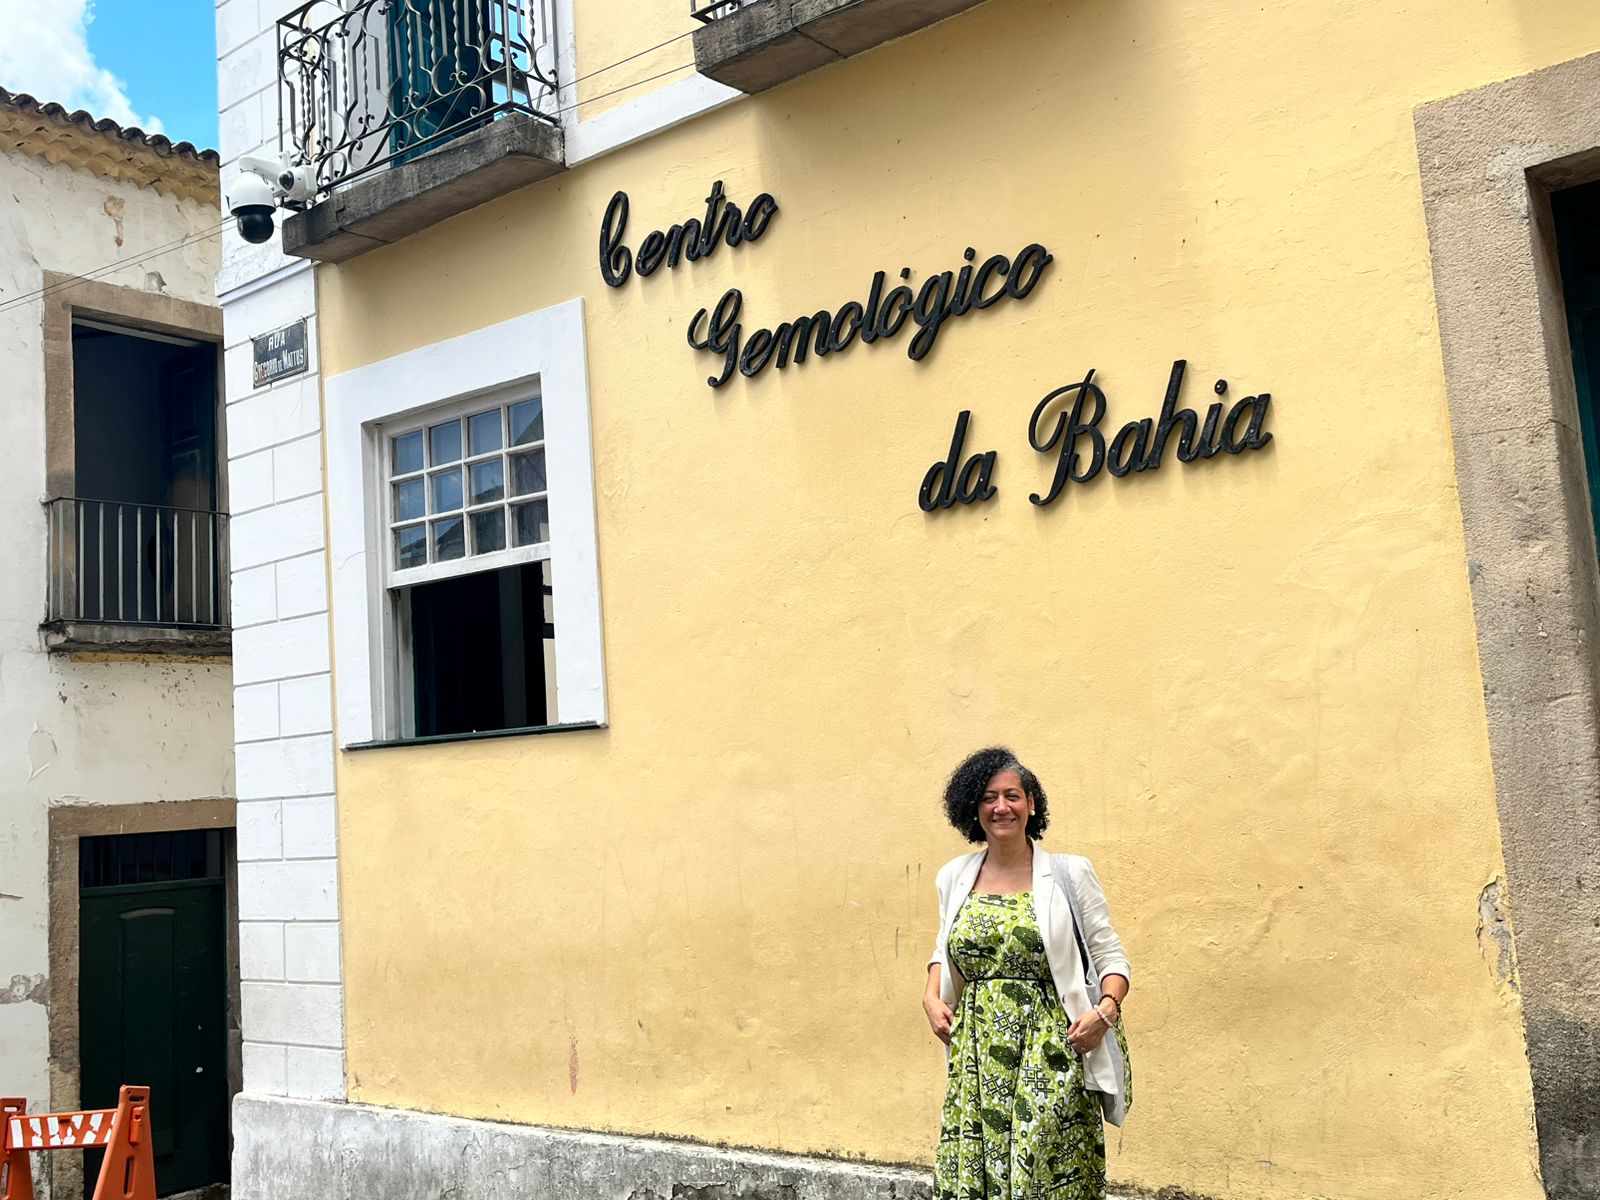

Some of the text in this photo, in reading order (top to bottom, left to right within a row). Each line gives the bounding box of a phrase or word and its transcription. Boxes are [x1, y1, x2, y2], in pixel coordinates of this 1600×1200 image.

[600, 181, 779, 287] Centro
[268, 331, 286, 351] RUA
[687, 243, 1053, 388] Gemológico
[919, 359, 1273, 513] da Bahia
